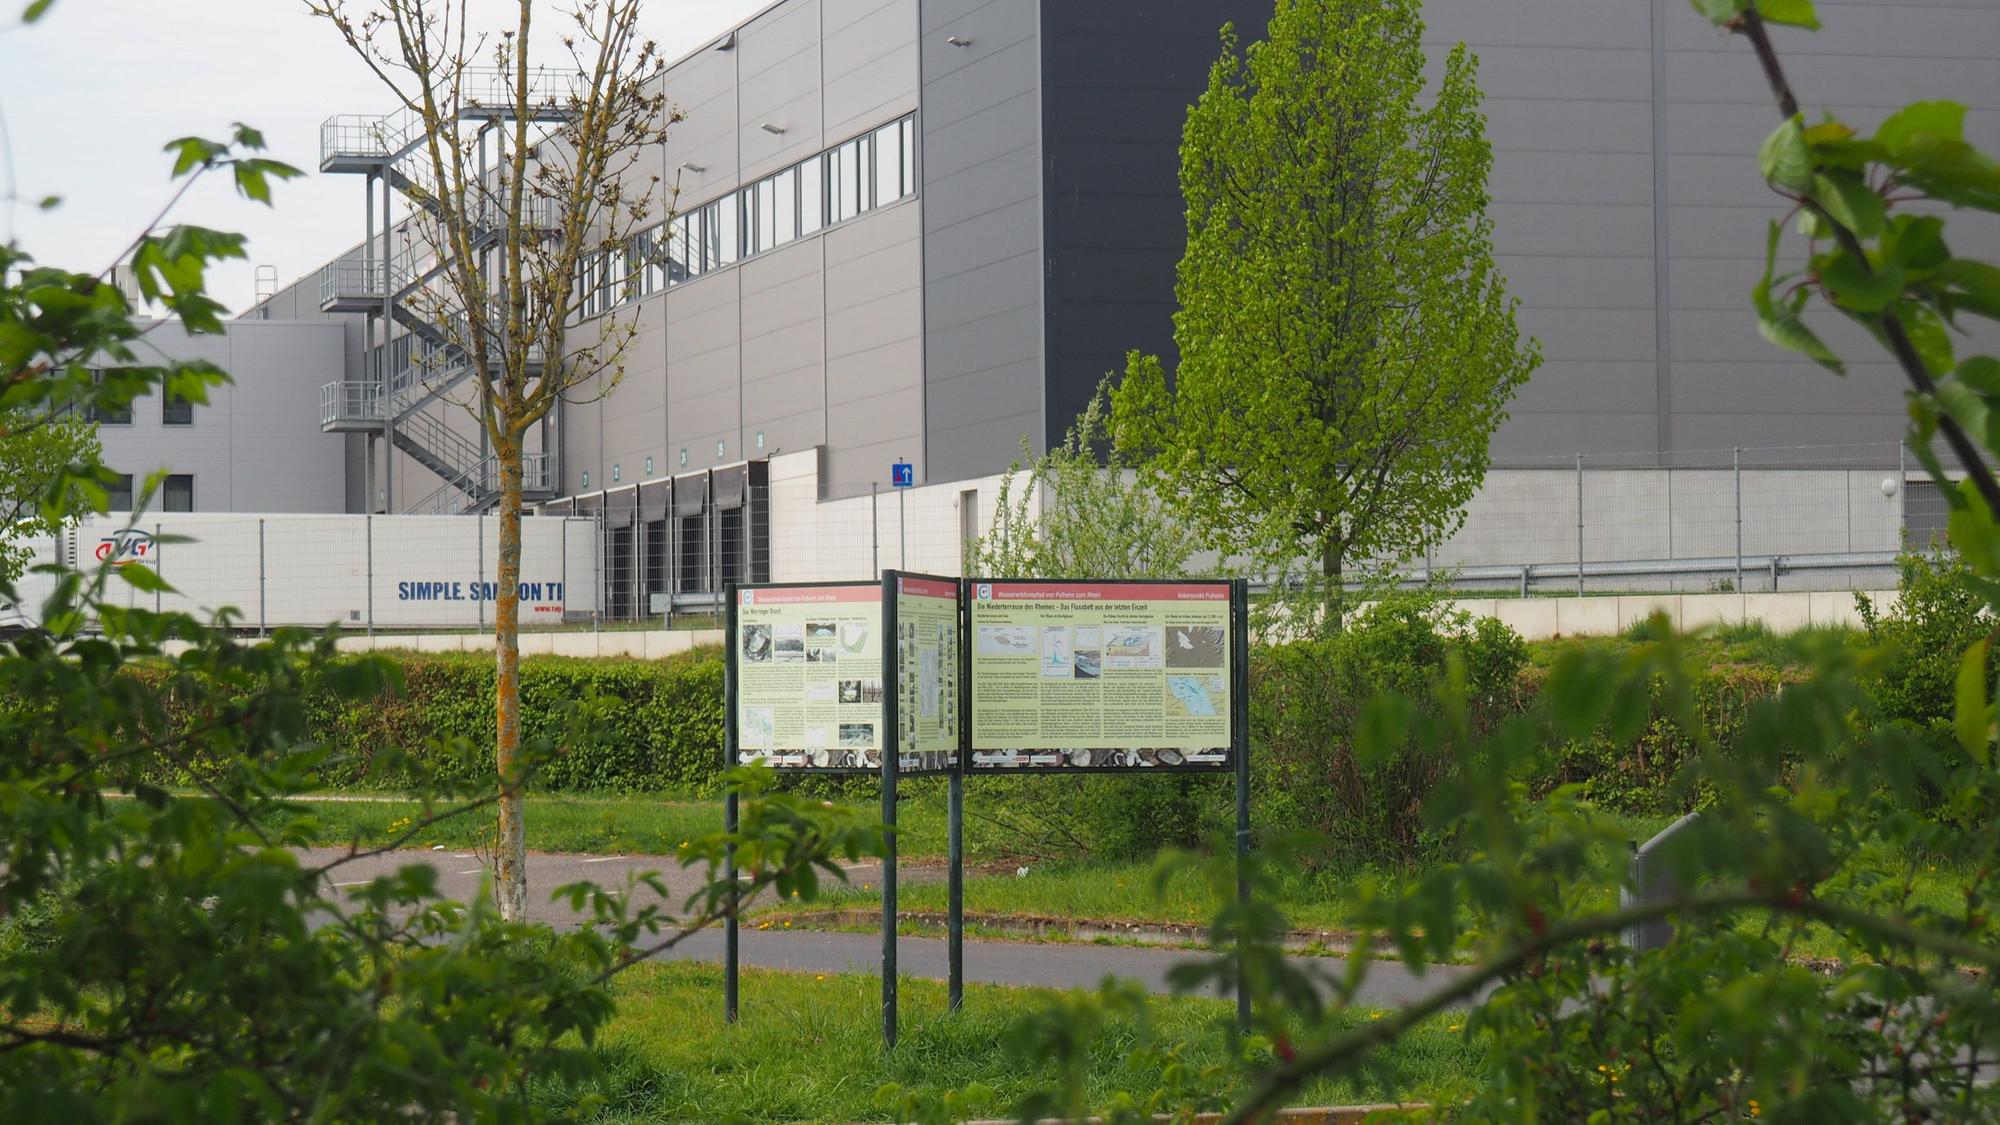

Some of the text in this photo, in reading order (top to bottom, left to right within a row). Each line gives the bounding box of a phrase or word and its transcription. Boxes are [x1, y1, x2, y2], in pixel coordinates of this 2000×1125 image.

[399, 582, 465, 601] SIMPLE.
[977, 602, 986, 610] Die
[986, 602, 1023, 610] Niederterrasse
[1024, 602, 1034, 610] des
[1034, 602, 1055, 610] Rheines
[1060, 602, 1070, 610] Das
[1071, 602, 1093, 610] Flussbett
